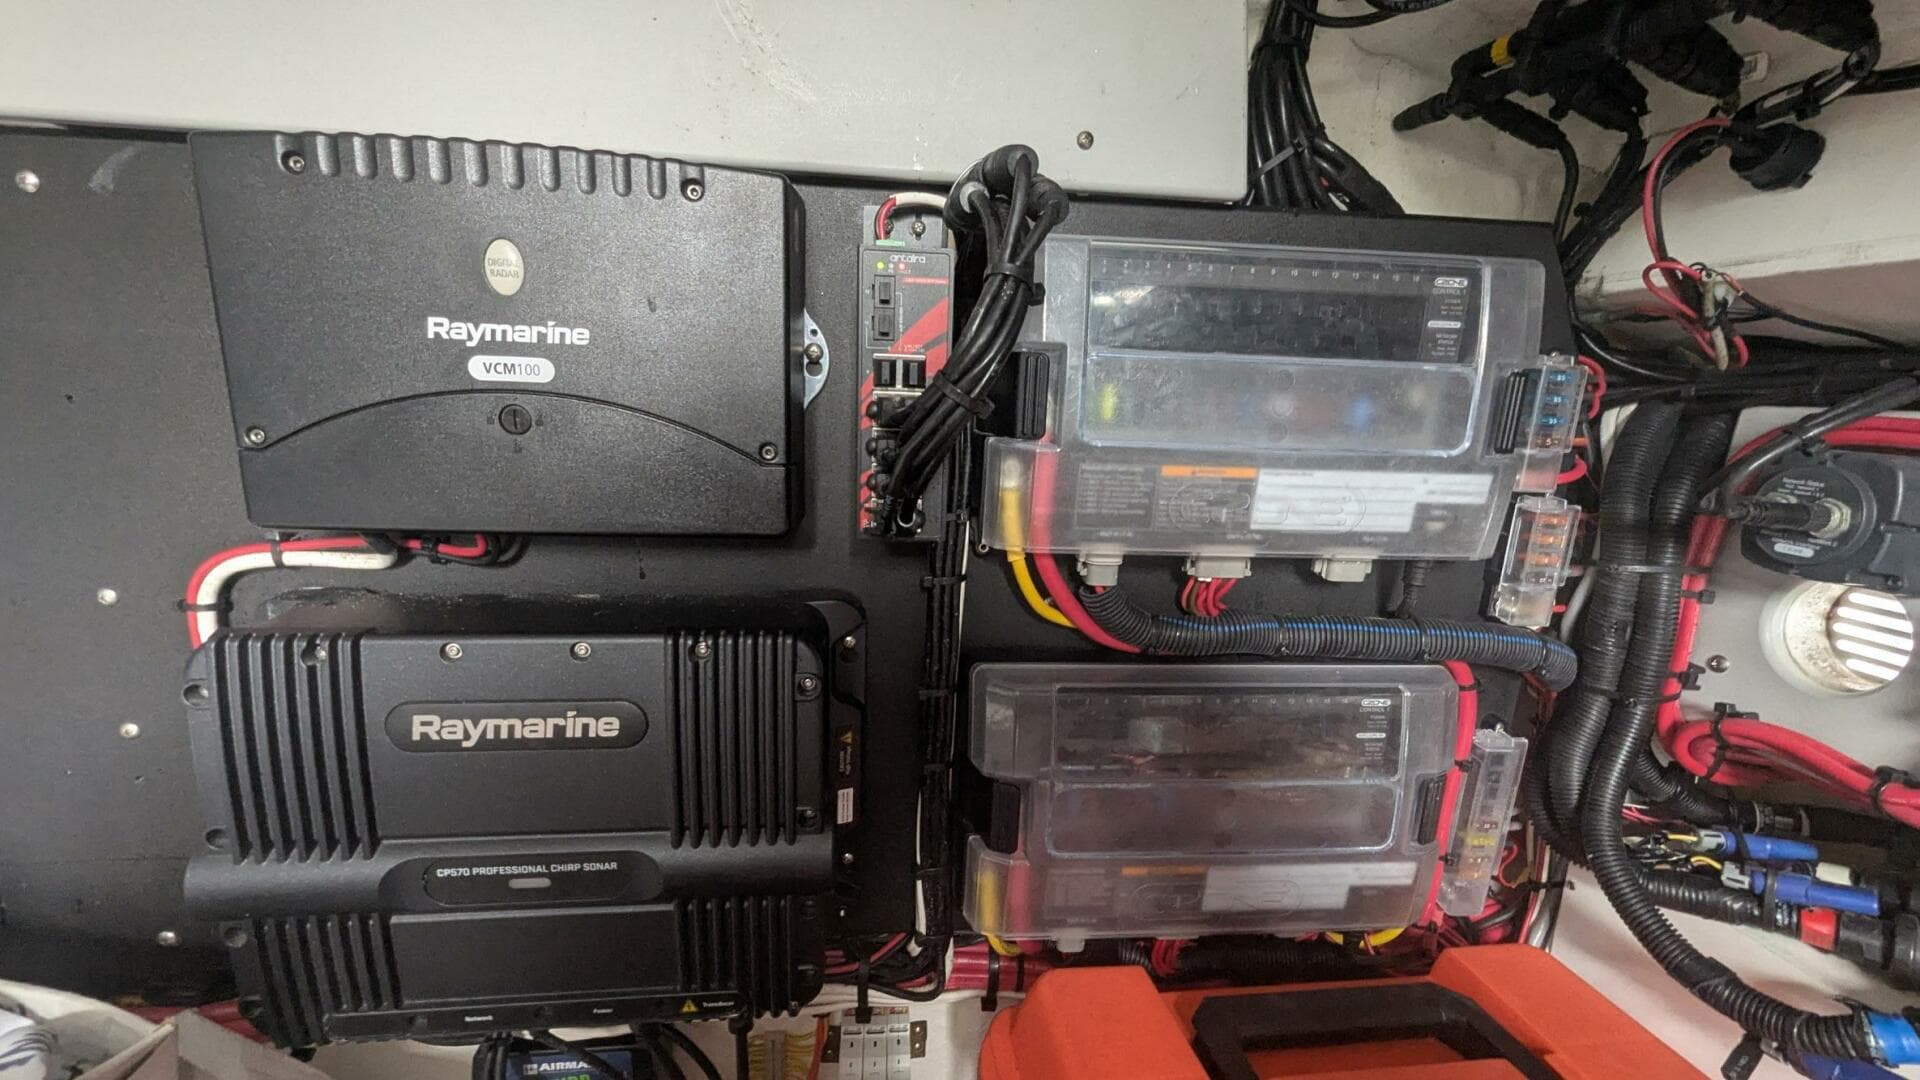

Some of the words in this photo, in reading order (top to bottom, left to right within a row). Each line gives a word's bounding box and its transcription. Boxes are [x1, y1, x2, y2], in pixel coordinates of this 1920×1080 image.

[488, 258, 521, 268] DIGITAL
[490, 269, 520, 279] RADAR
[427, 317, 590, 347] Raymarine
[483, 362, 541, 377] VCM100
[411, 710, 620, 748] Raymarine
[436, 868, 471, 878] CP570
[472, 864, 549, 877] PROFESSIONAL
[550, 863, 580, 873] CHIRP
[583, 861, 619, 872] SONAR
[539, 1061, 592, 1071] AIRMA
